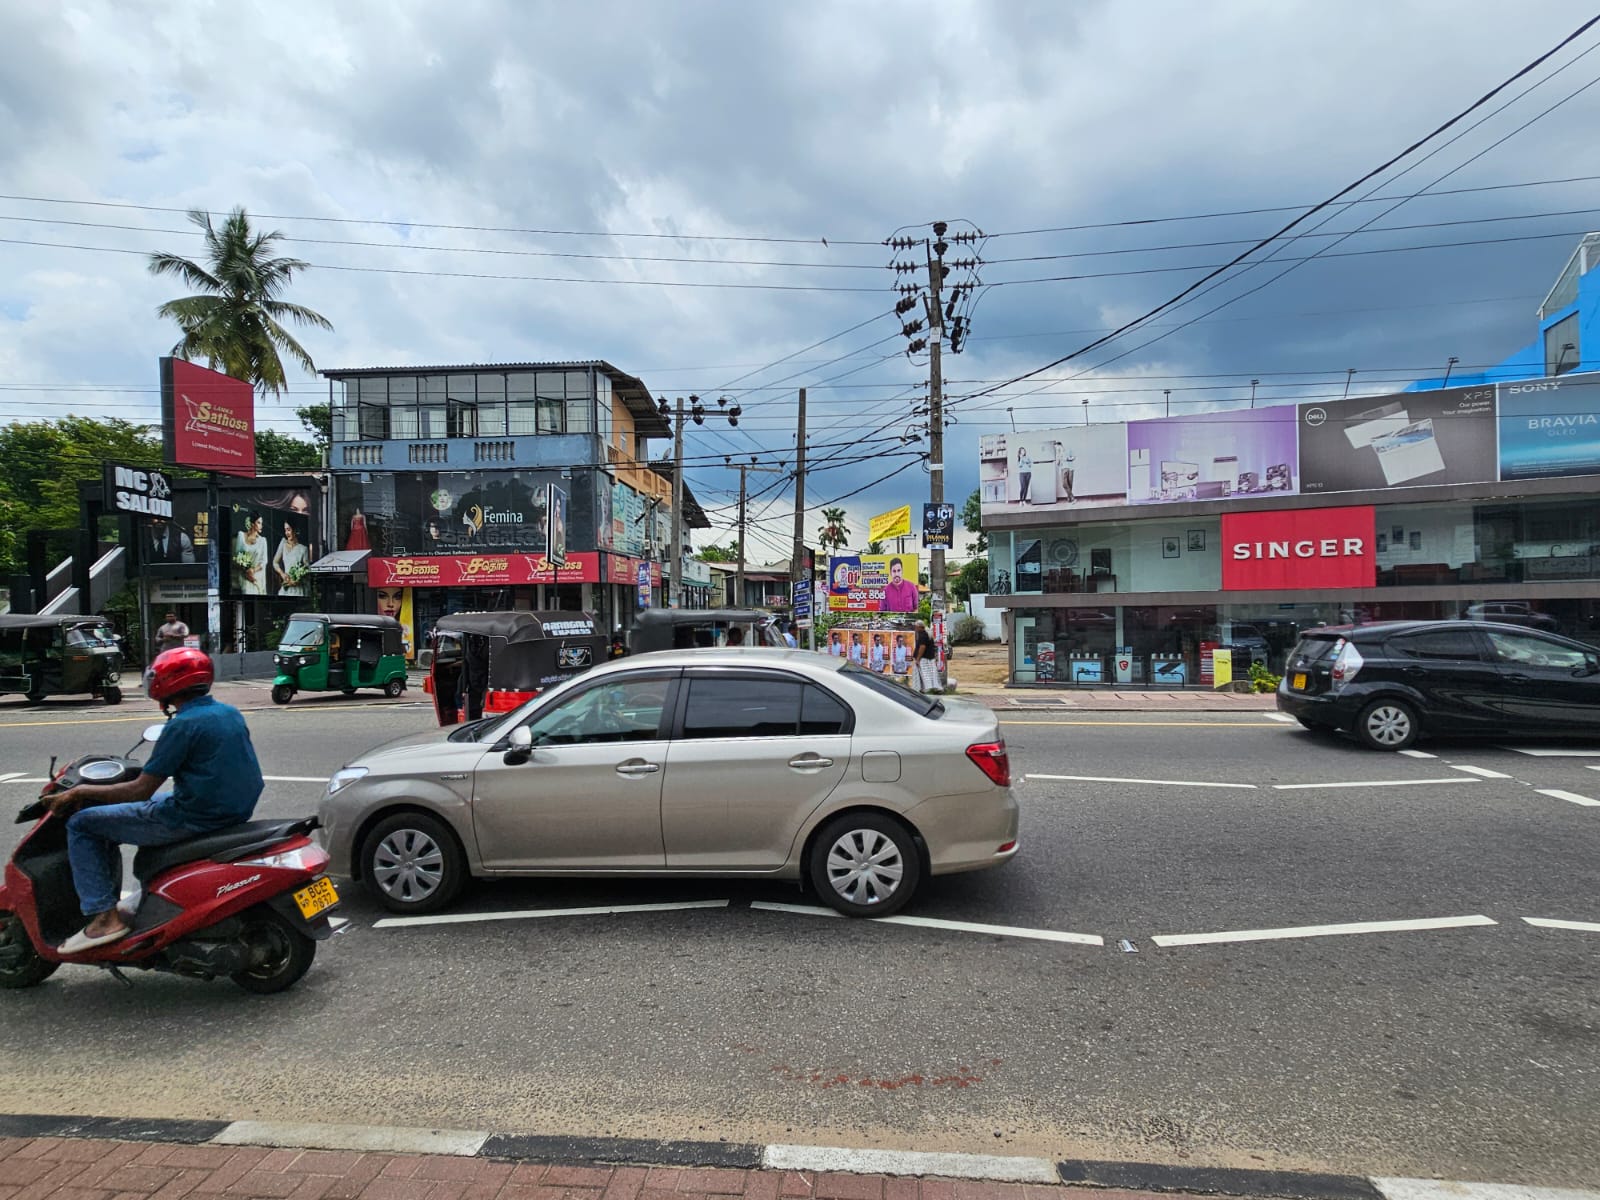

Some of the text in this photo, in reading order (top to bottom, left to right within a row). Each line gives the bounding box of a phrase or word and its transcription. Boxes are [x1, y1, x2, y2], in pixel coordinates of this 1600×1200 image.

[1463, 390, 1493, 401] XPS
[1509, 381, 1563, 395] SONY
[197, 402, 248, 431] Sathosa
[1528, 414, 1598, 430] BRAVIA
[1547, 429, 1577, 437] OLED
[115, 466, 148, 491] NC
[116, 491, 172, 517] SALON
[484, 509, 523, 523] Femina
[937, 507, 953, 519] ICT
[1233, 538, 1364, 560] SINGER
[396, 559, 440, 576] සතොස
[537, 556, 583, 572] Saosa
[861, 577, 889, 585] ECONOMICS
[216, 873, 261, 898] Pleasure
